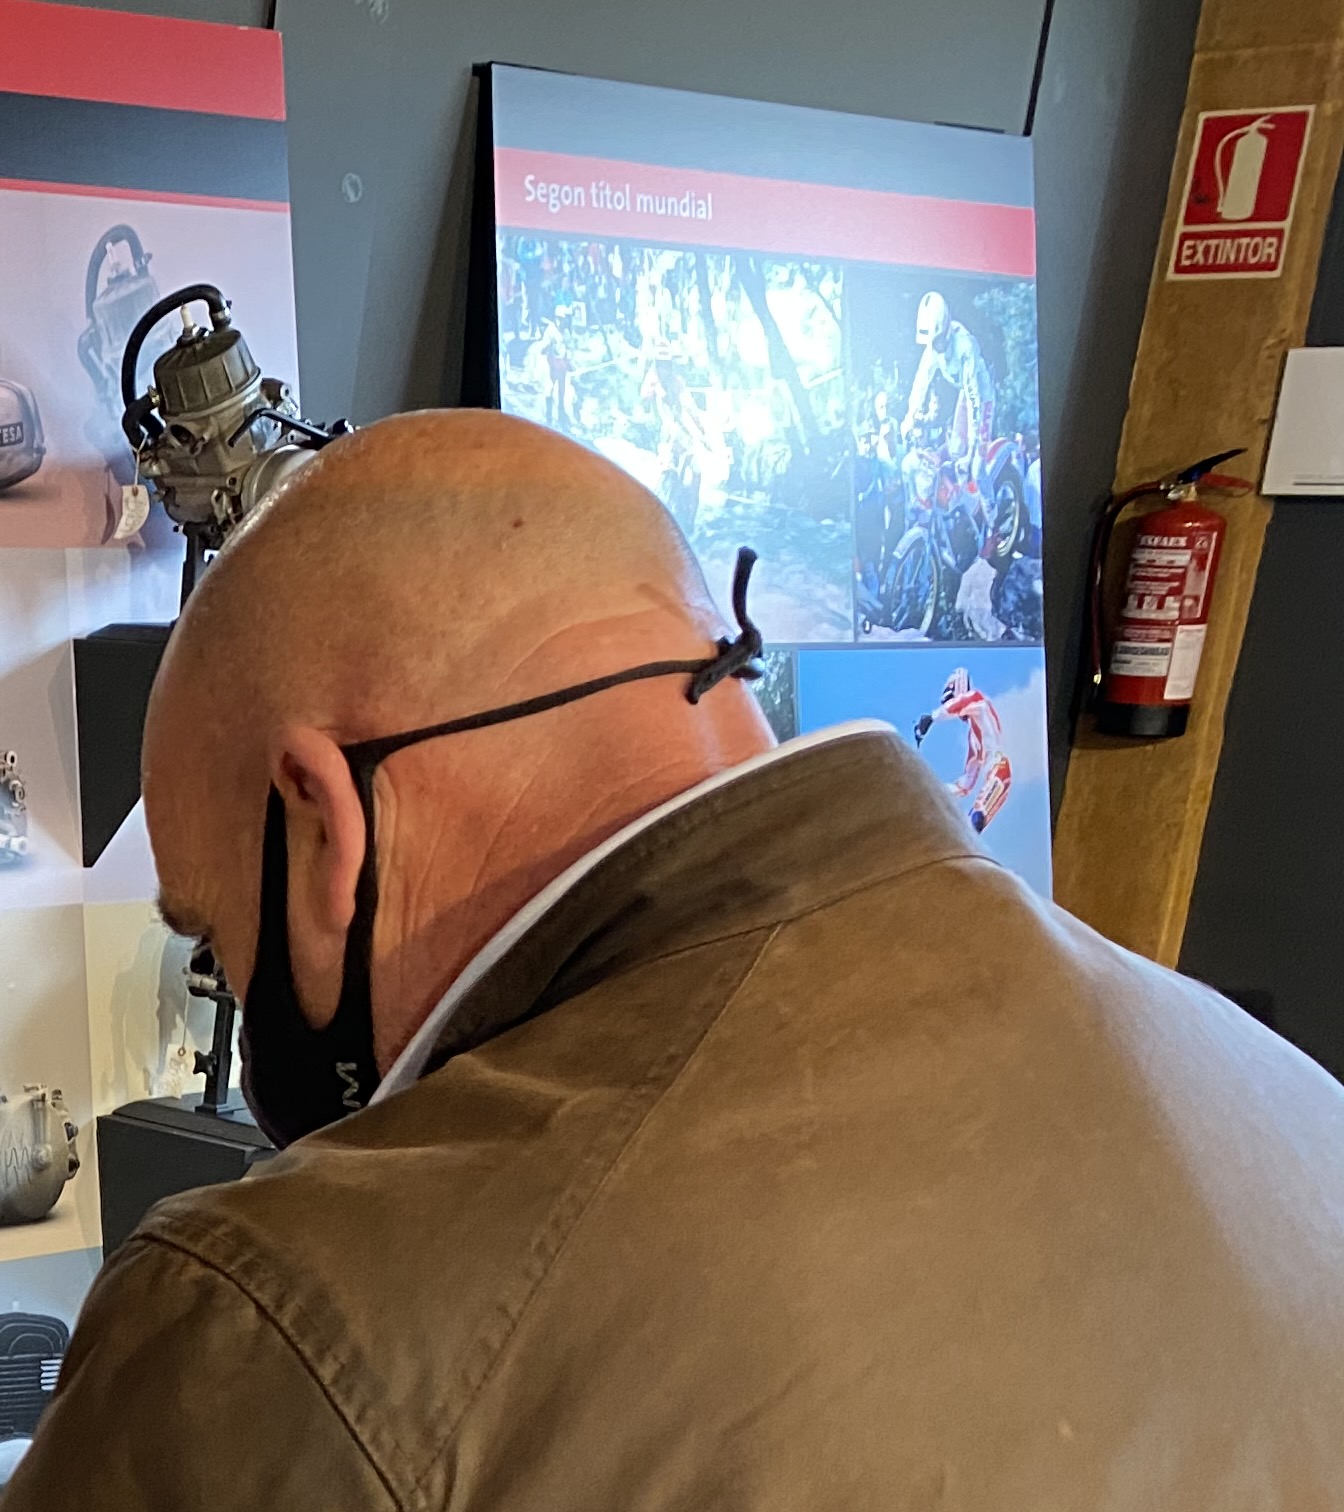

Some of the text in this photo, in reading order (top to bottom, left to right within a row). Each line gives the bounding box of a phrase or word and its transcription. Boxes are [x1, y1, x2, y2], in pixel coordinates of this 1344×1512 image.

[524, 174, 713, 221] Segon títol mundial
[1180, 236, 1279, 266] EXTINTOR
